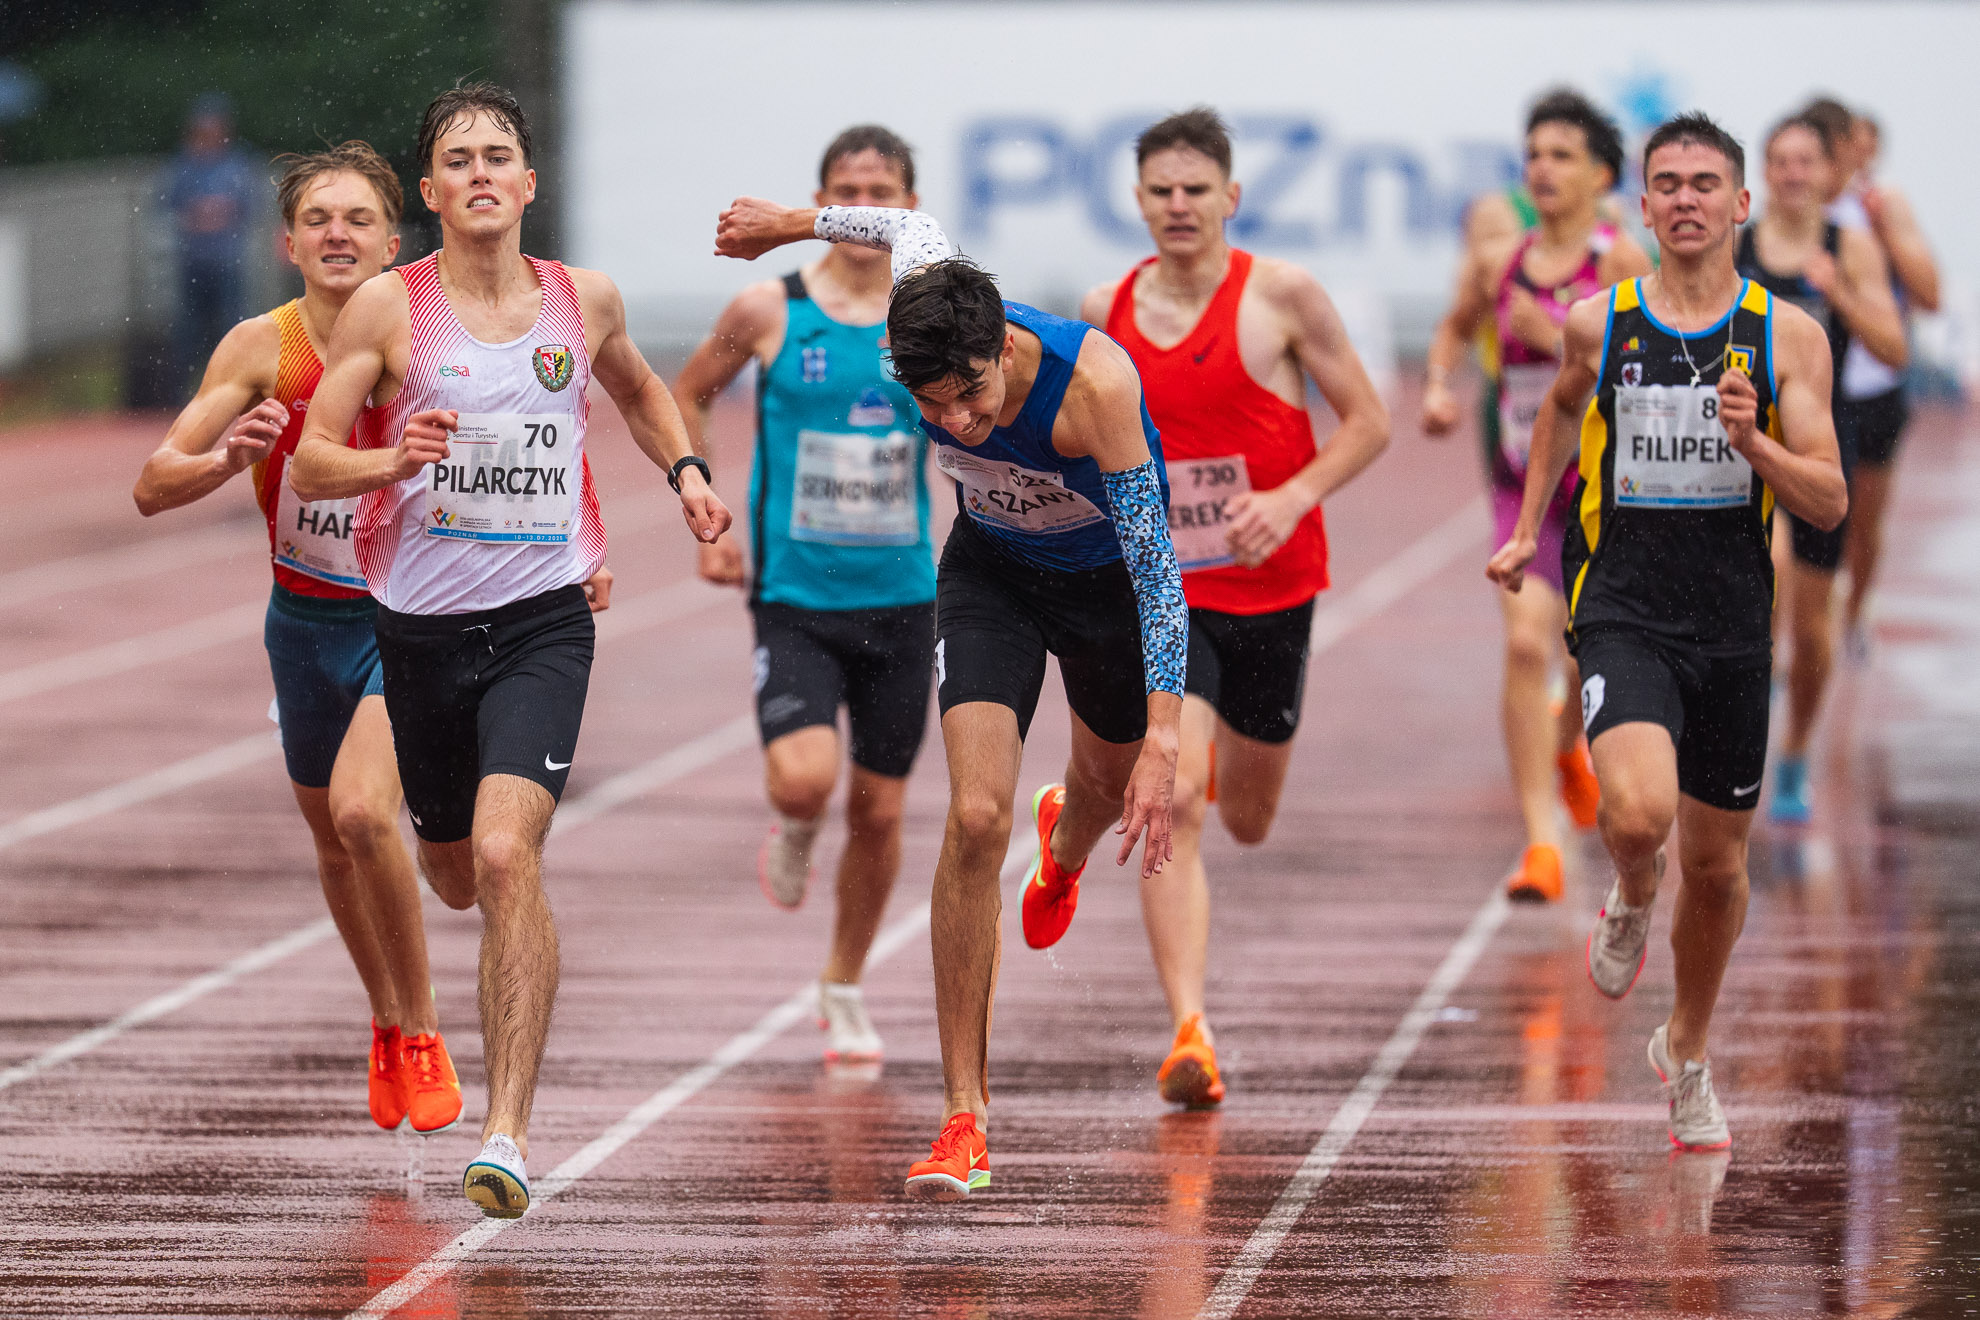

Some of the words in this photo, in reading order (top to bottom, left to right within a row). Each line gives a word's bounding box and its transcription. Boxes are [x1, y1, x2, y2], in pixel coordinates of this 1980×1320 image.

[440, 365, 470, 377] esa
[1702, 397, 1717, 420] 8
[524, 423, 558, 449] 70
[1631, 435, 1735, 463] FILIPEK
[433, 463, 567, 496] PILARCZYK
[1188, 463, 1238, 488] 730
[974, 489, 1076, 515] SZANY
